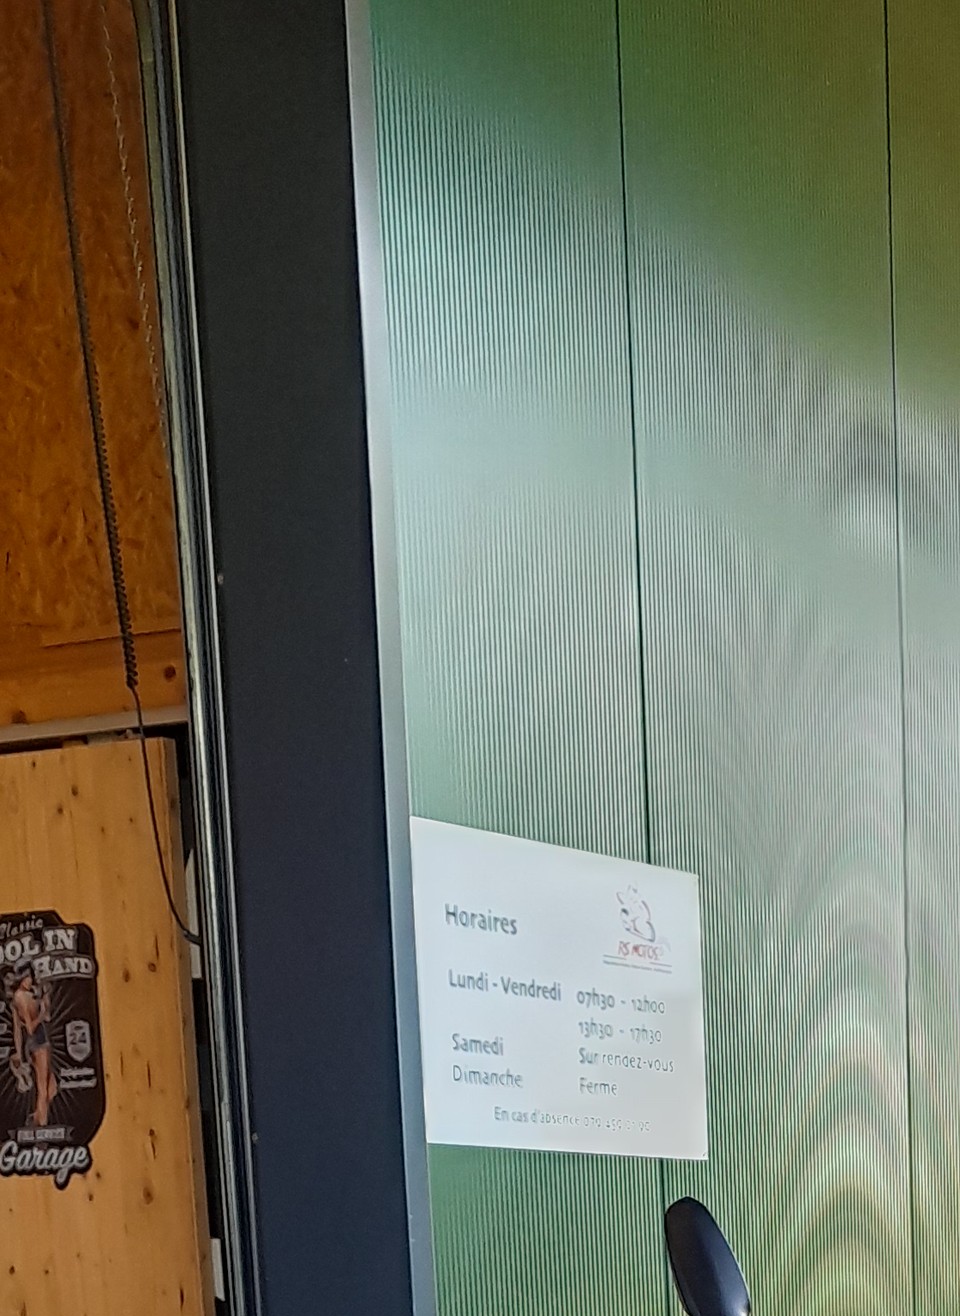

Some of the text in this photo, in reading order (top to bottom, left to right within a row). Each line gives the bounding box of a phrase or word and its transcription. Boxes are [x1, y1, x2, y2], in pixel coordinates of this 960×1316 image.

[445, 904, 517, 935] Horaires
[44, 928, 75, 951] IN
[449, 969, 489, 992] Lundi
[500, 976, 562, 1001] Vendredi
[577, 987, 615, 1010] 07h30
[632, 994, 665, 1014] 12h00
[578, 1017, 613, 1040] 13h30
[630, 1024, 662, 1045] 17h30
[452, 1033, 674, 1073] Samedi Sur rendez-vous
[452, 1064, 523, 1088] Dimanche
[494, 1106, 509, 1121] En
[511, 1111, 529, 1123] cas
[0, 1140, 89, 1185] Garage
